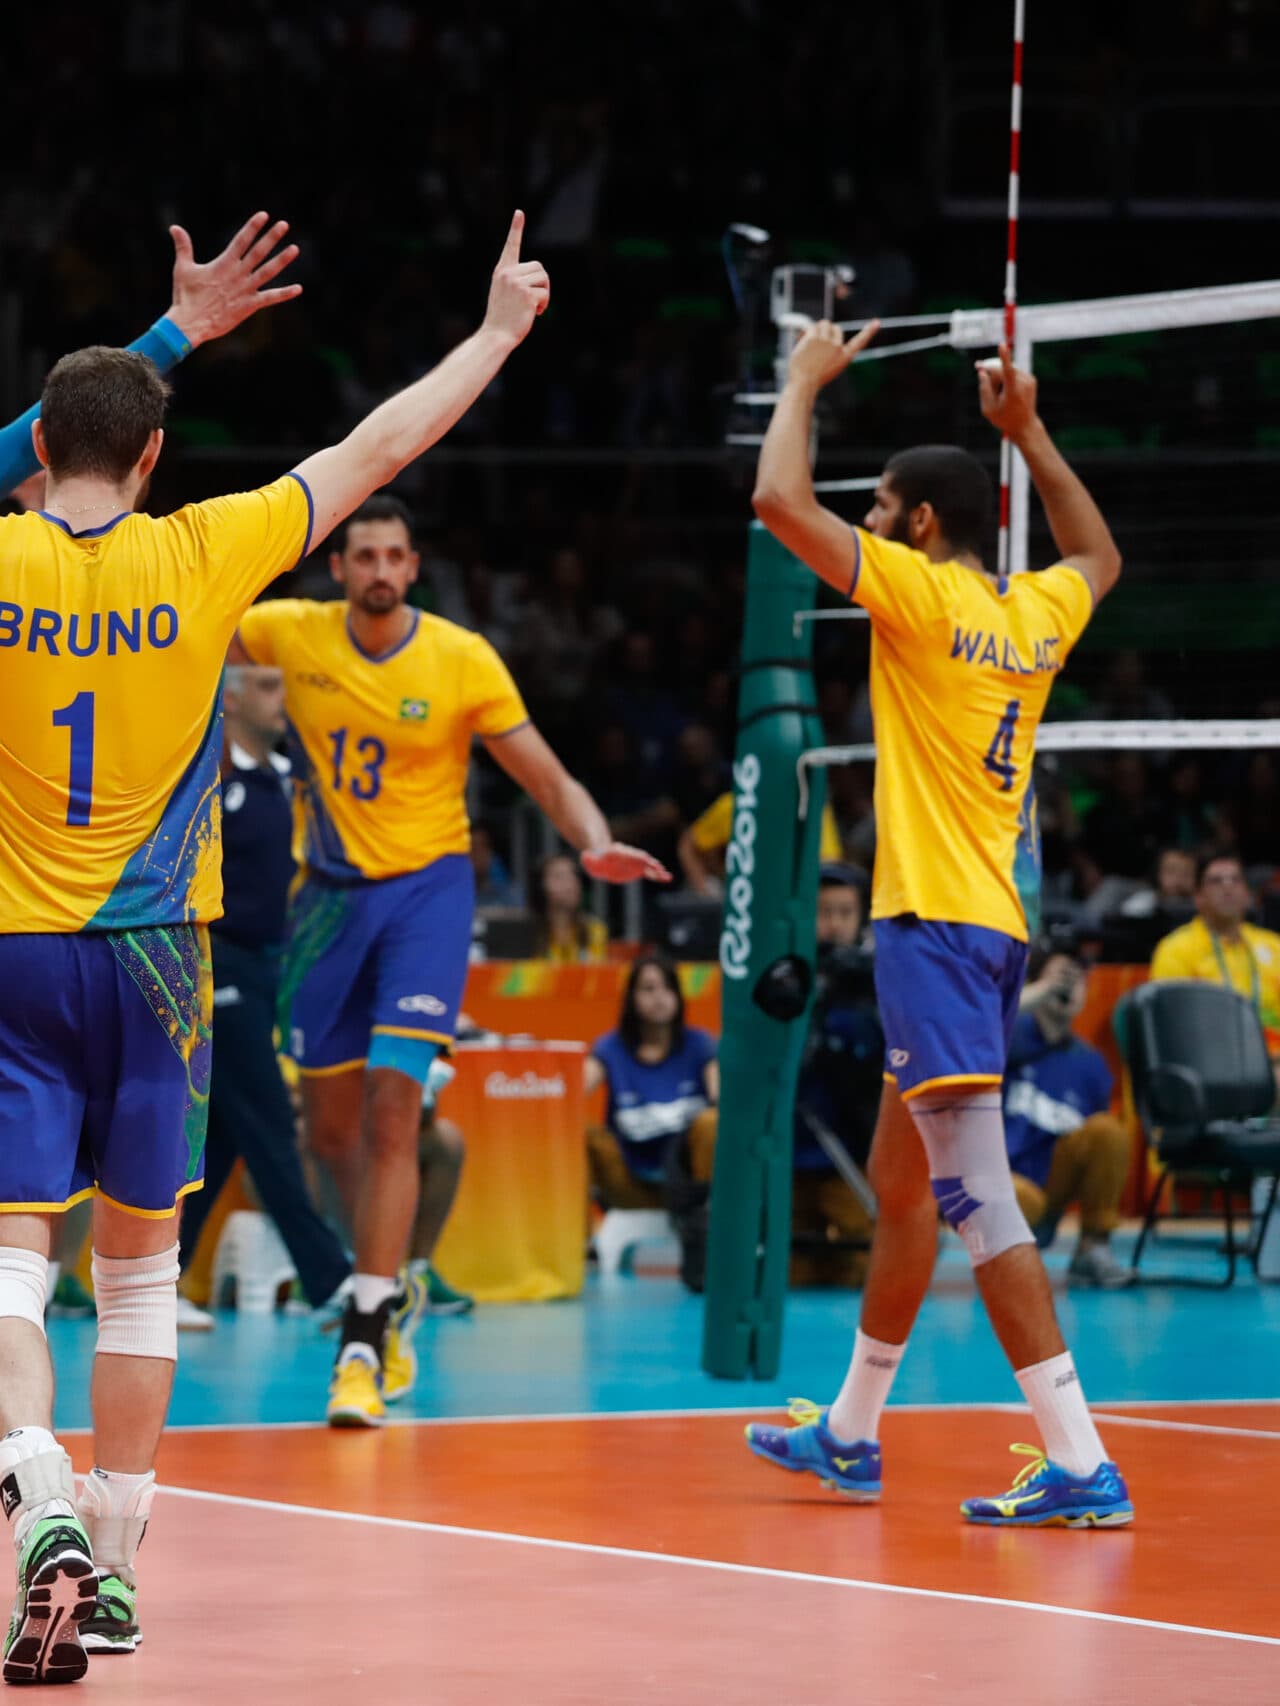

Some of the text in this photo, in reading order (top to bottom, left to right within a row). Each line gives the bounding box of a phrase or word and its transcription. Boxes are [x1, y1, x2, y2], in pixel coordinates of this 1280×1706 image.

[52, 691, 95, 826] 1
[328, 727, 387, 801] 13
[983, 699, 1020, 791] 4
[719, 753, 761, 980] Rio2016
